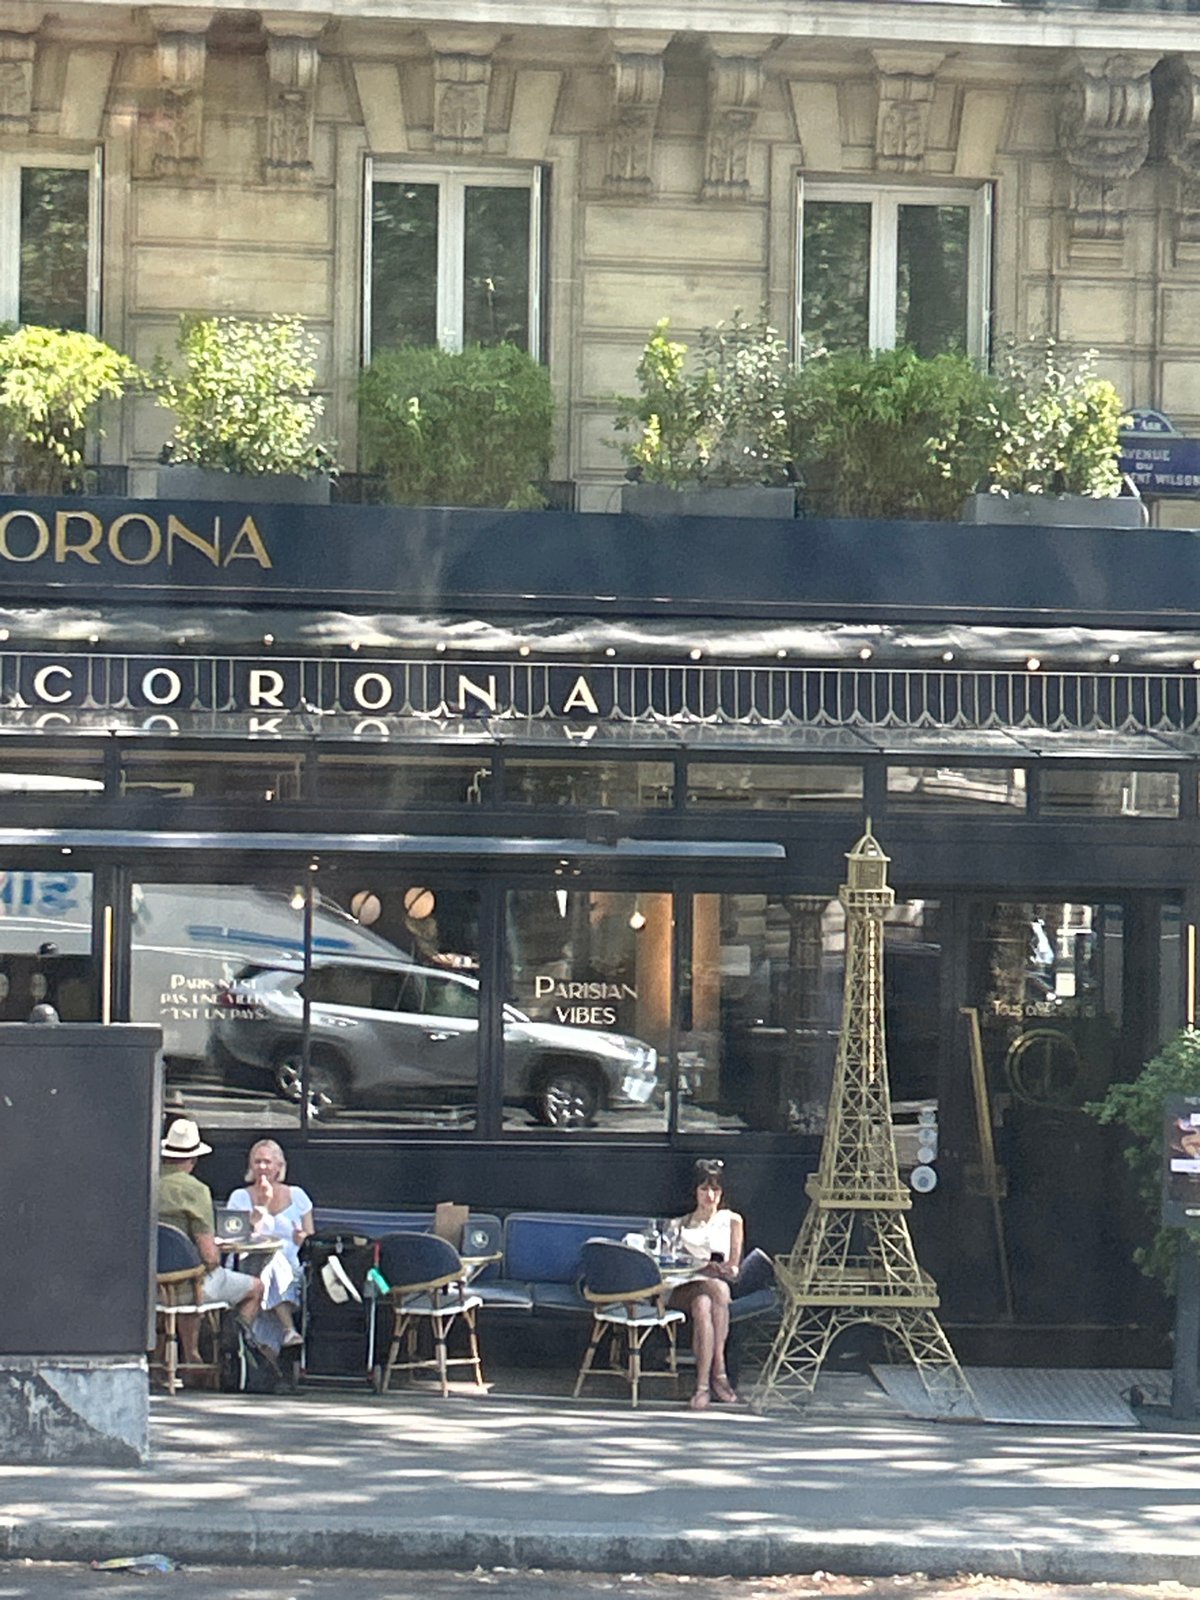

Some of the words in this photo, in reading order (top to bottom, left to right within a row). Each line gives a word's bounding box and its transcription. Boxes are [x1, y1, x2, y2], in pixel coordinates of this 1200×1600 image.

[1135, 462, 1154, 471] DU
[1129, 472, 1152, 485] ENT
[34, 664, 599, 715] CORONA
[535, 975, 639, 1000] PARISIAN
[555, 1005, 617, 1025] VIBES
